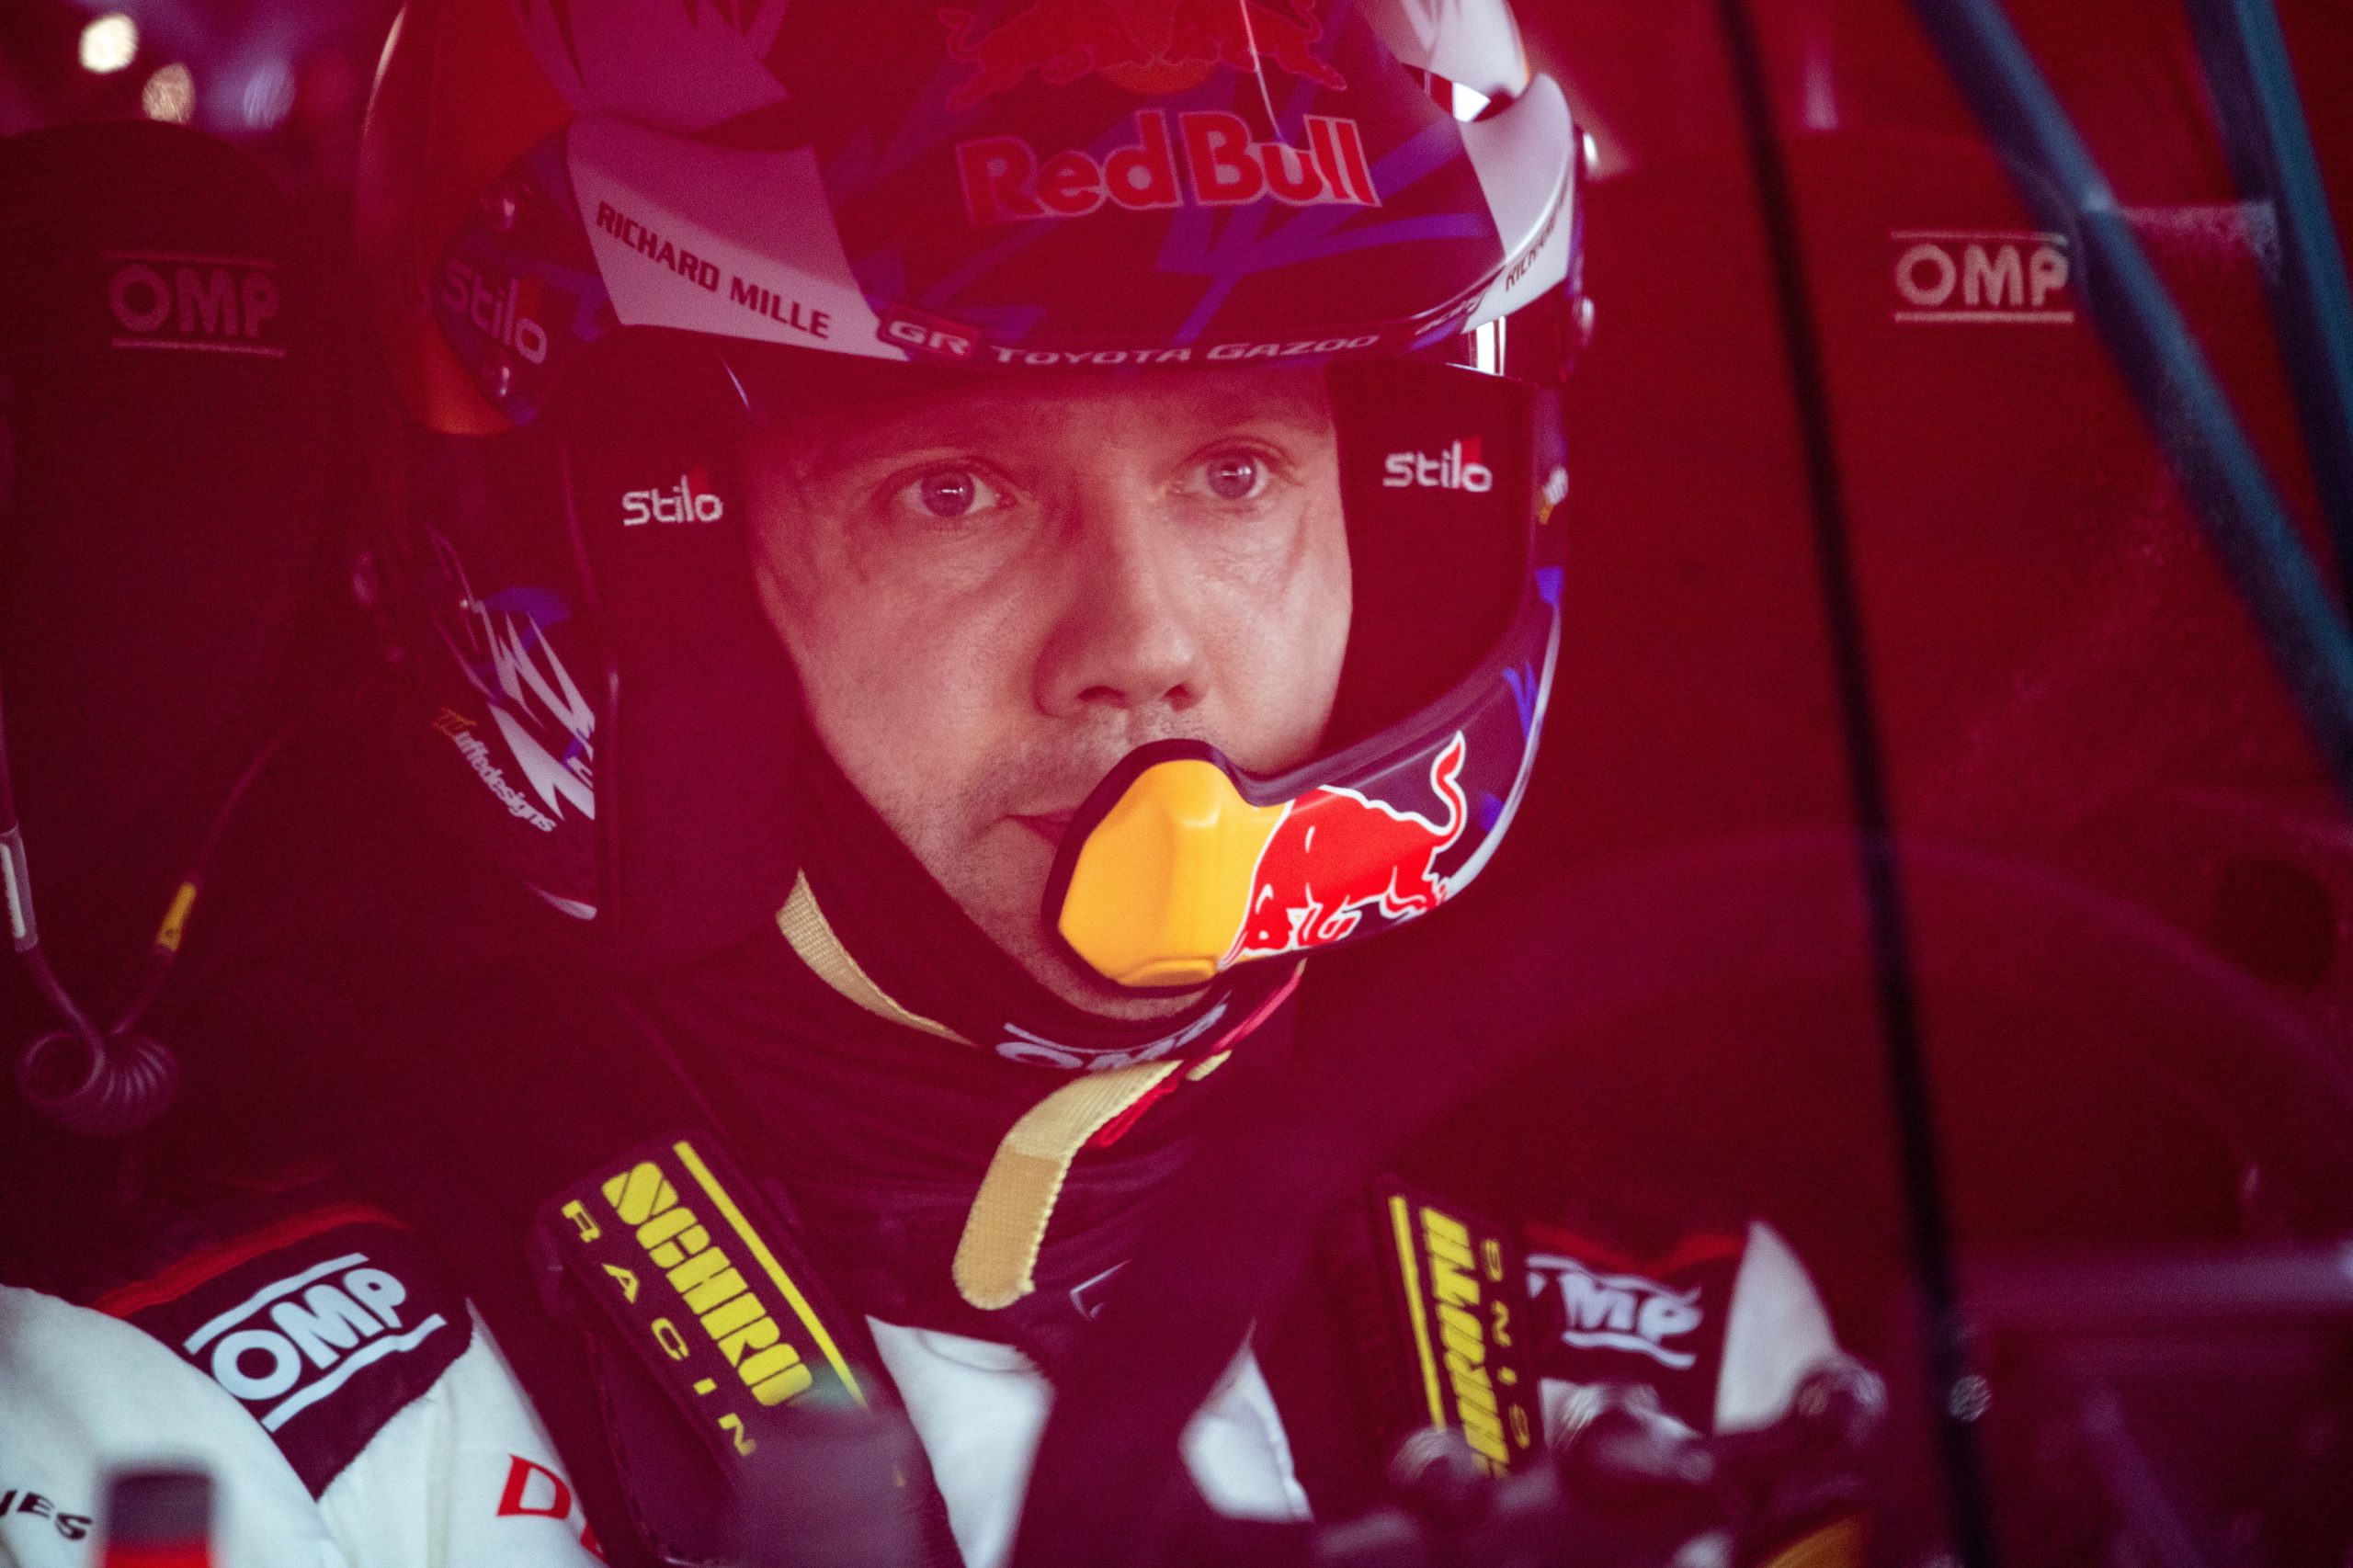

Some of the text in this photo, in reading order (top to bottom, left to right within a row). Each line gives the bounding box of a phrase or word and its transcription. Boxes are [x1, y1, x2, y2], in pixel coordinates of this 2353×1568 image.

[956, 108, 1383, 227] Red Bull
[108, 263, 280, 340] OMP
[597, 199, 832, 340] RICHARD MILLE
[1894, 243, 2070, 307] OMP
[887, 319, 1381, 366] GR TOYOTA GAZOO
[210, 1267, 407, 1402] OMP
[560, 1198, 757, 1458] RACIN
[601, 1160, 813, 1407] SCHRO
[1526, 1270, 1703, 1346] MP
